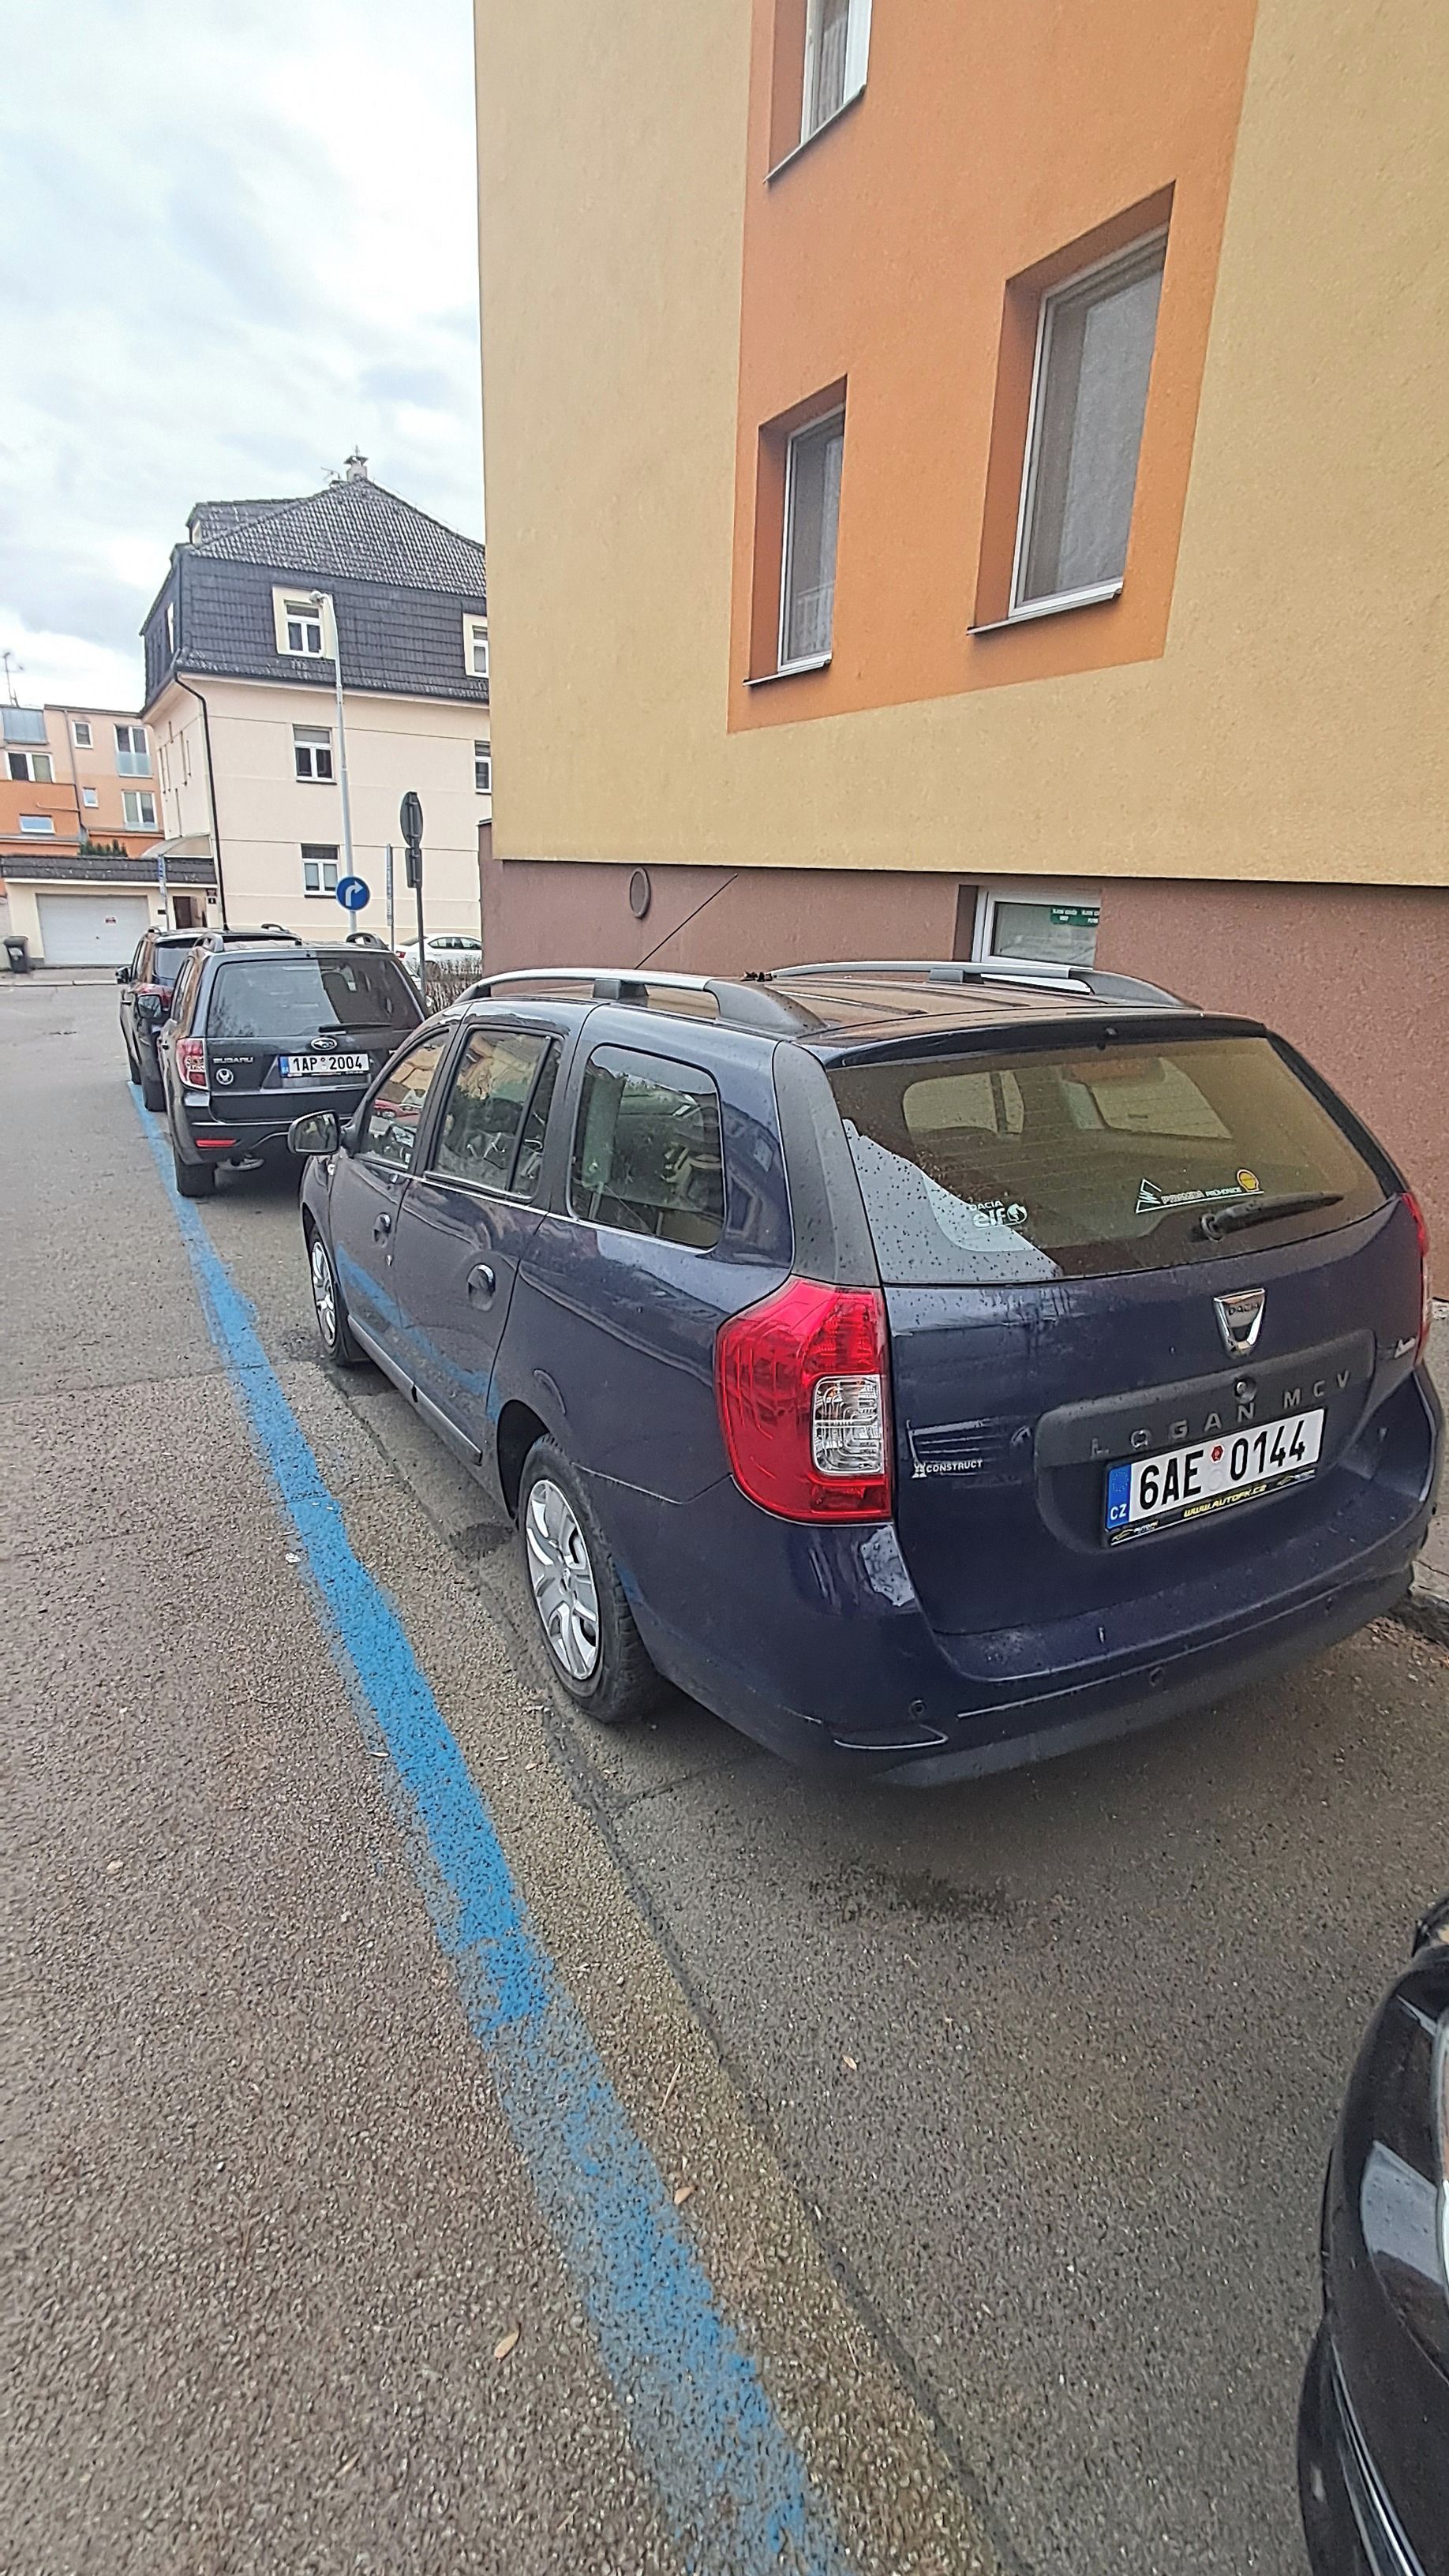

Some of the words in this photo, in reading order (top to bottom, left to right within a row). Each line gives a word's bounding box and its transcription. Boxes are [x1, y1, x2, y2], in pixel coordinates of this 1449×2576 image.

[293, 1058, 317, 1071] 1AP
[329, 1056, 362, 1070] 2004
[969, 1200, 1004, 1211] DACIA
[973, 1208, 1006, 1228] elf
[1091, 1402, 1256, 1458] LOGAN
[1283, 1369, 1350, 1410] MCV
[926, 1459, 983, 1473] CONSTRUCT
[1139, 1449, 1204, 1511] 6AE
[1230, 1420, 1306, 1481] 0144
[1110, 1503, 1127, 1521] CZ
